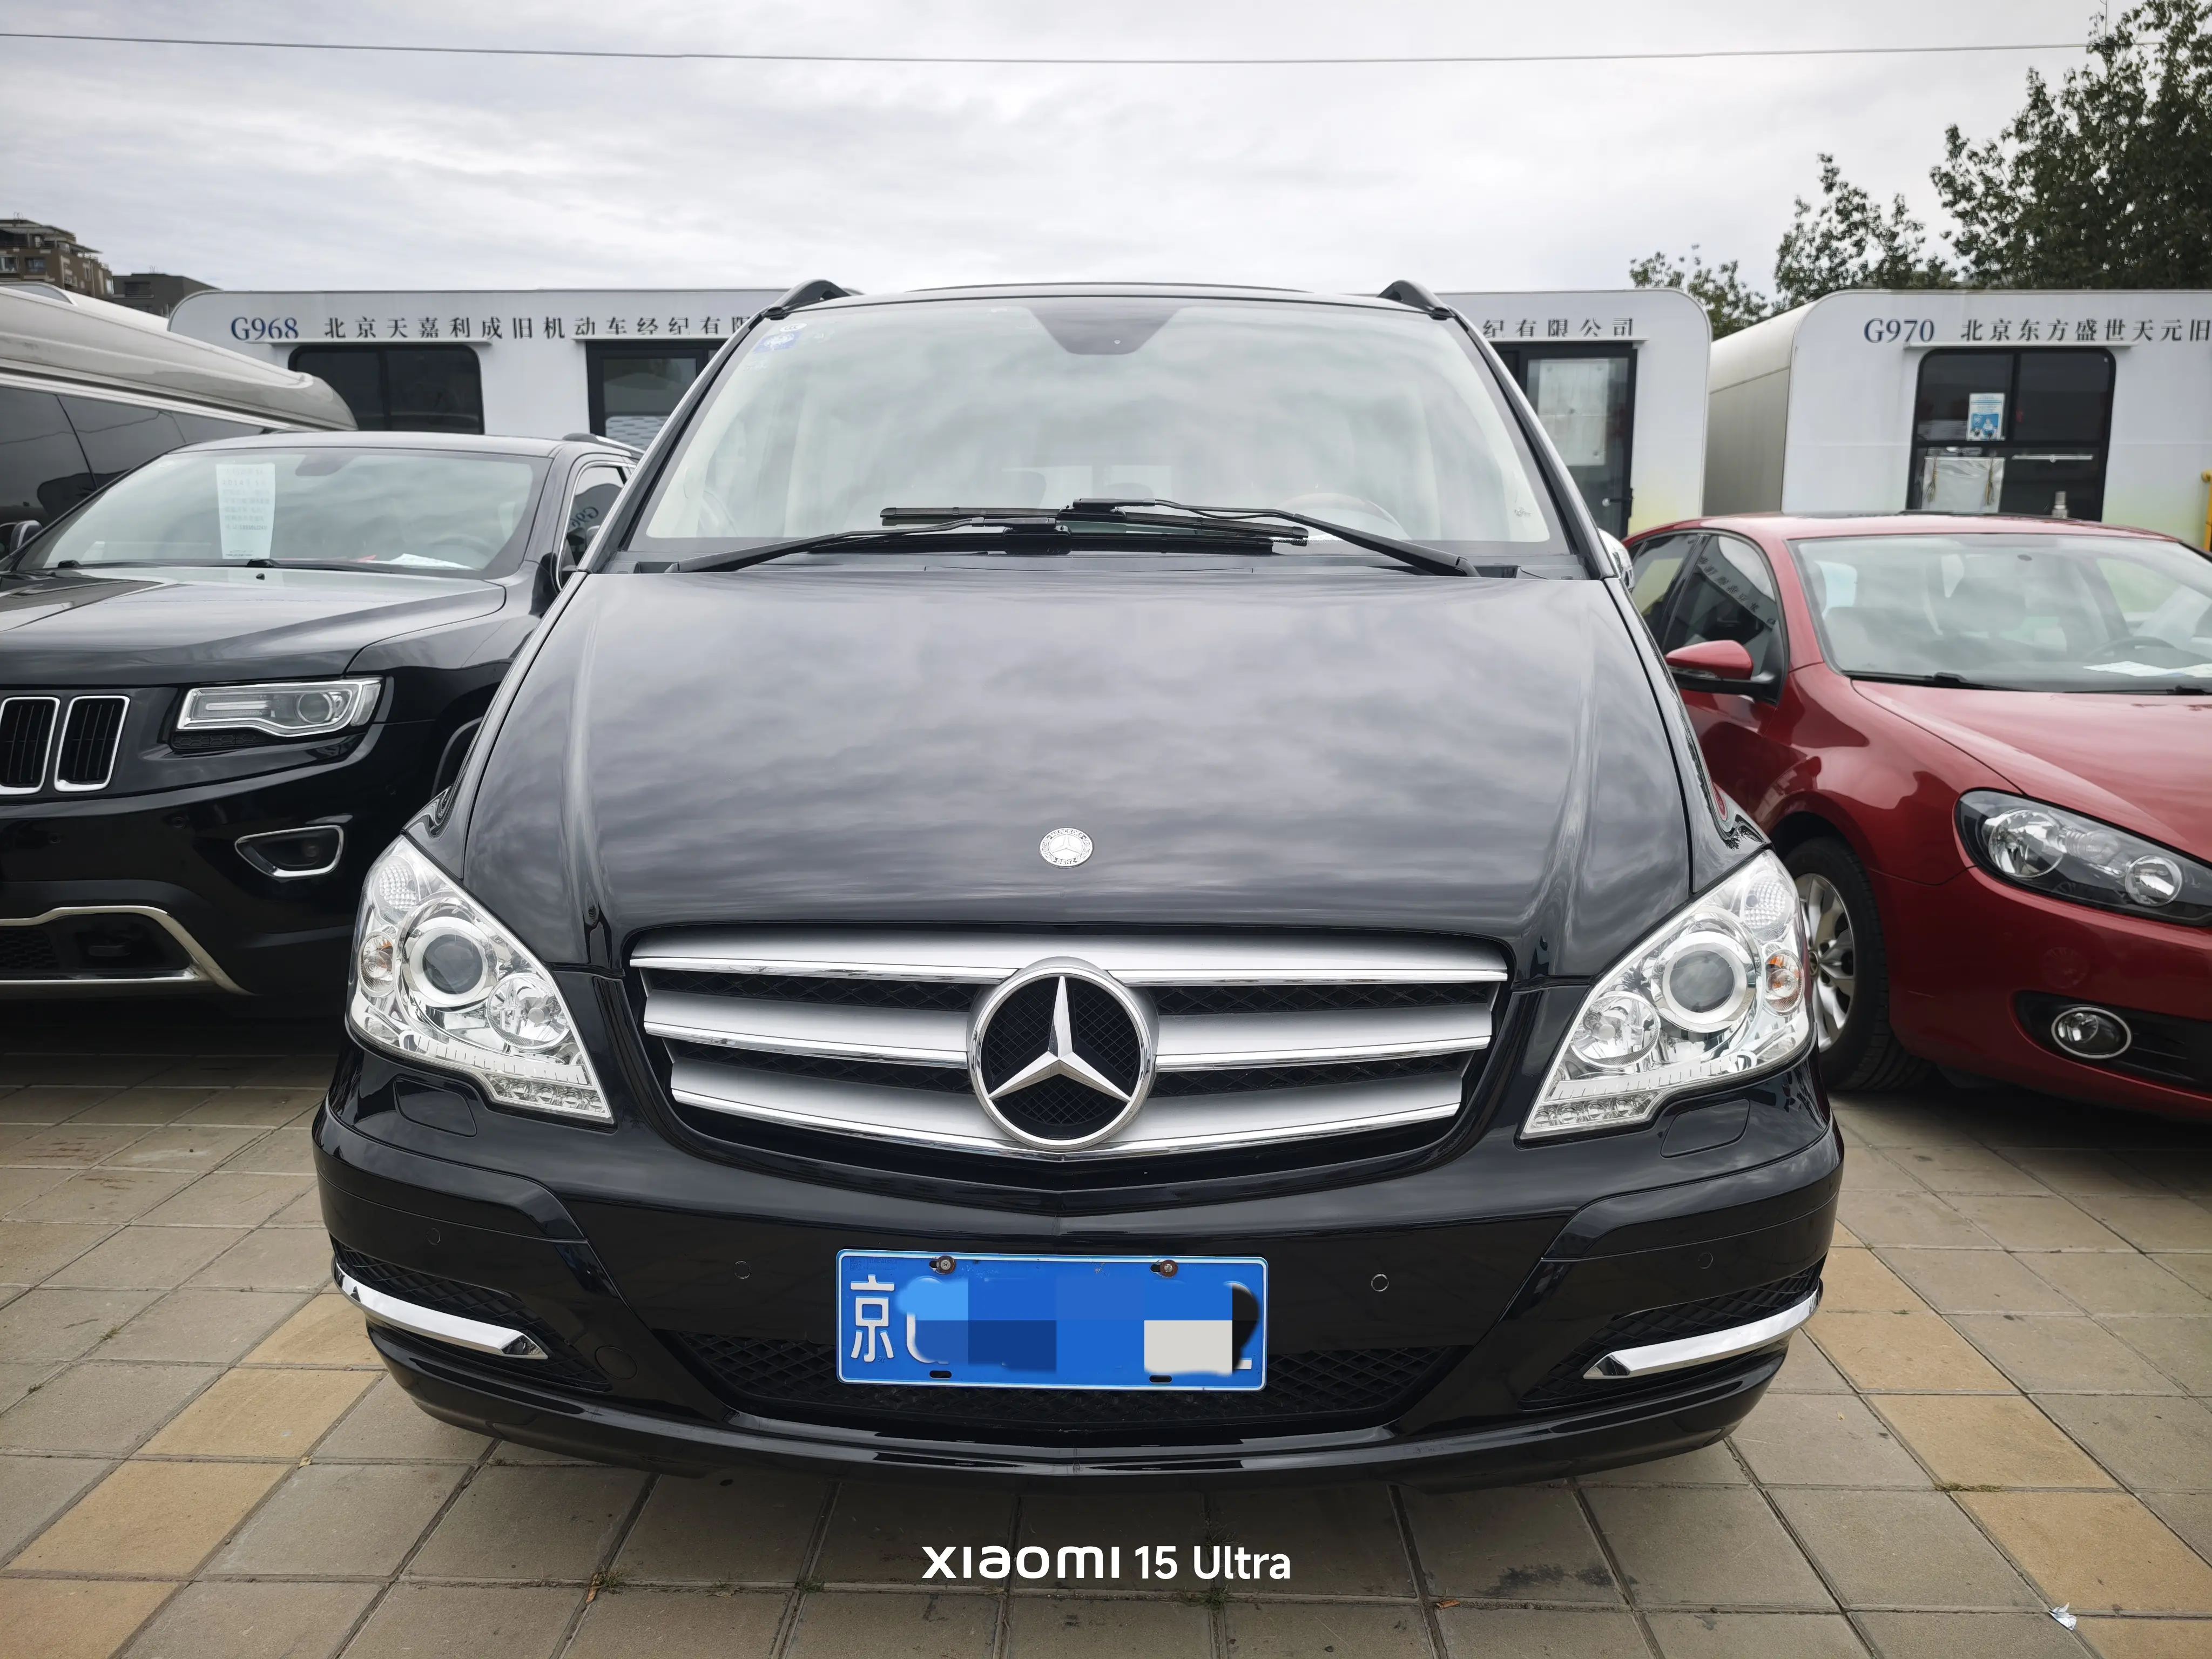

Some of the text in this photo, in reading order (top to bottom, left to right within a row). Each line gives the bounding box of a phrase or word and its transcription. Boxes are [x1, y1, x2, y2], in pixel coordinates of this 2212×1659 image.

[231, 316, 299, 340] G968
[1482, 317, 1634, 338] 纪有限公司
[1864, 318, 1934, 343] G970
[1960, 318, 2211, 341] 北京东方盛世天元旧
